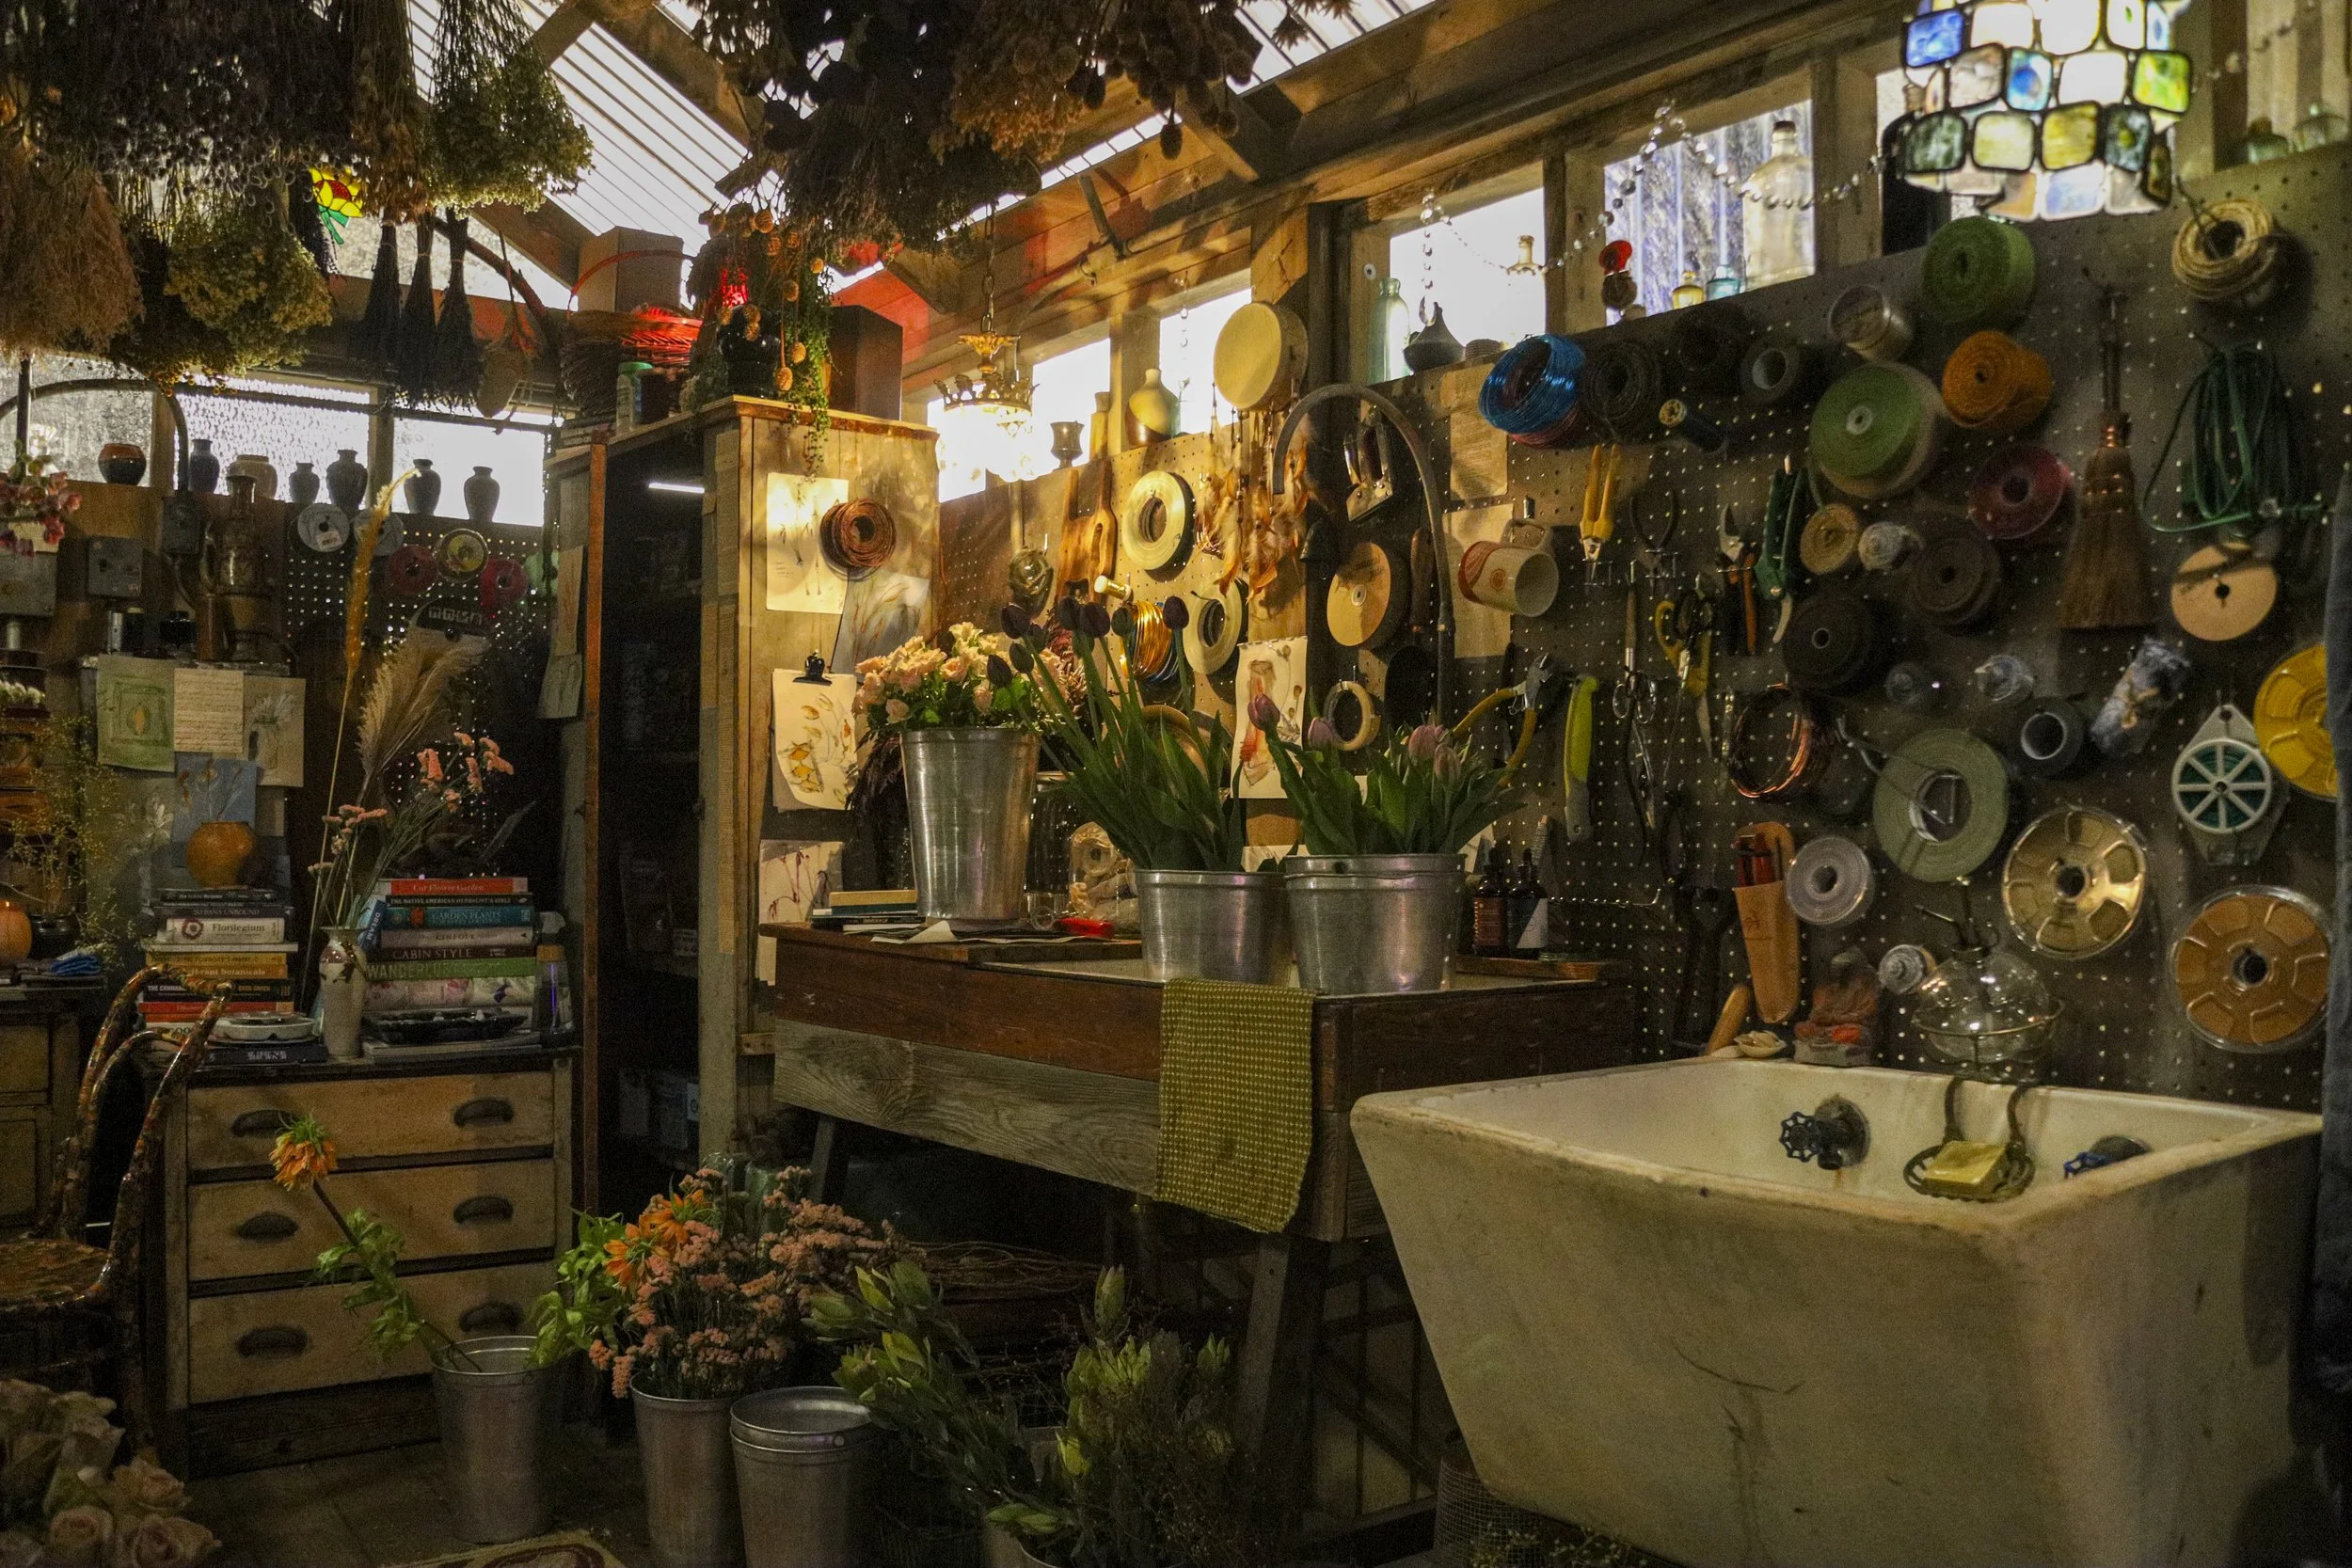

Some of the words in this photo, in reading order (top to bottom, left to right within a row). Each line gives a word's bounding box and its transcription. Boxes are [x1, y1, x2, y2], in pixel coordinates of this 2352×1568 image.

[213, 923, 265, 933] Florilegium
[392, 949, 431, 959] CABIN
[437, 948, 471, 958] STYLE
